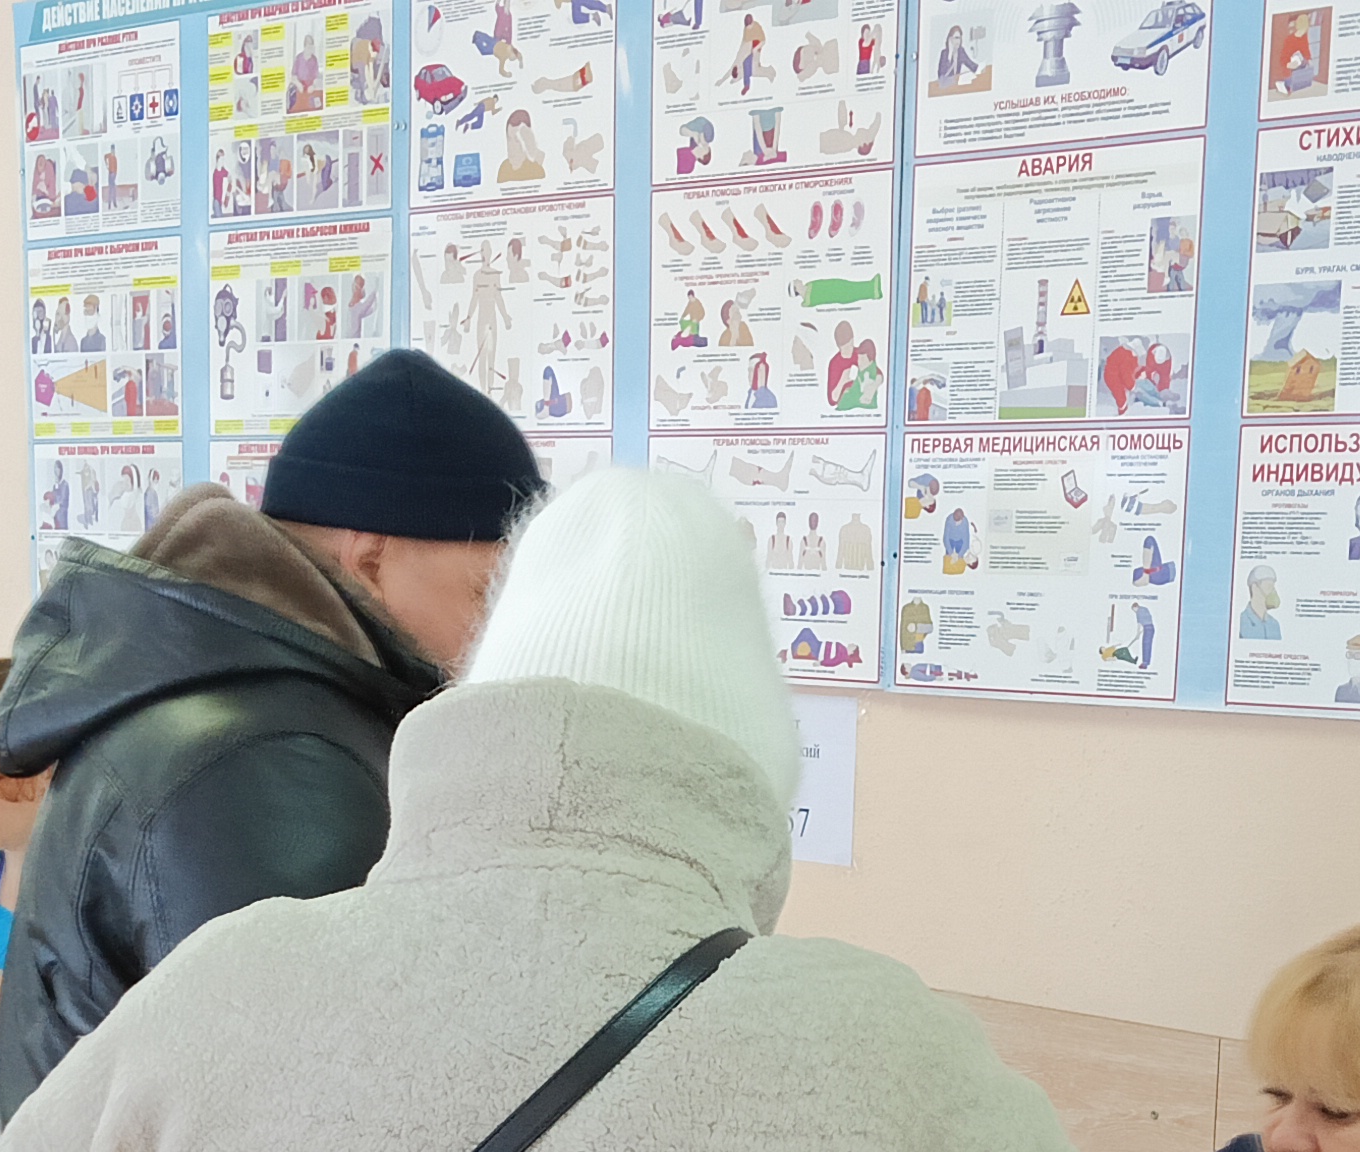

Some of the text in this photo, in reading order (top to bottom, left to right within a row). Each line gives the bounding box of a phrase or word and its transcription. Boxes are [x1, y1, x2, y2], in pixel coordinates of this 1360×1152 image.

[42, 1, 100, 33] ДЕЙСТВИЕ
[993, 96, 1041, 111] УСЛЫШАВ
[1060, 86, 1130, 103] НЕОБХОДИМО:
[1017, 152, 1093, 177] АВАРИЯ
[911, 437, 974, 454] ПЕРВАЯ
[978, 434, 1100, 455] МЕДИЦИНСКАЯ
[1261, 488, 1335, 498] ОРГАНОВ ДЫХАНИЯ
